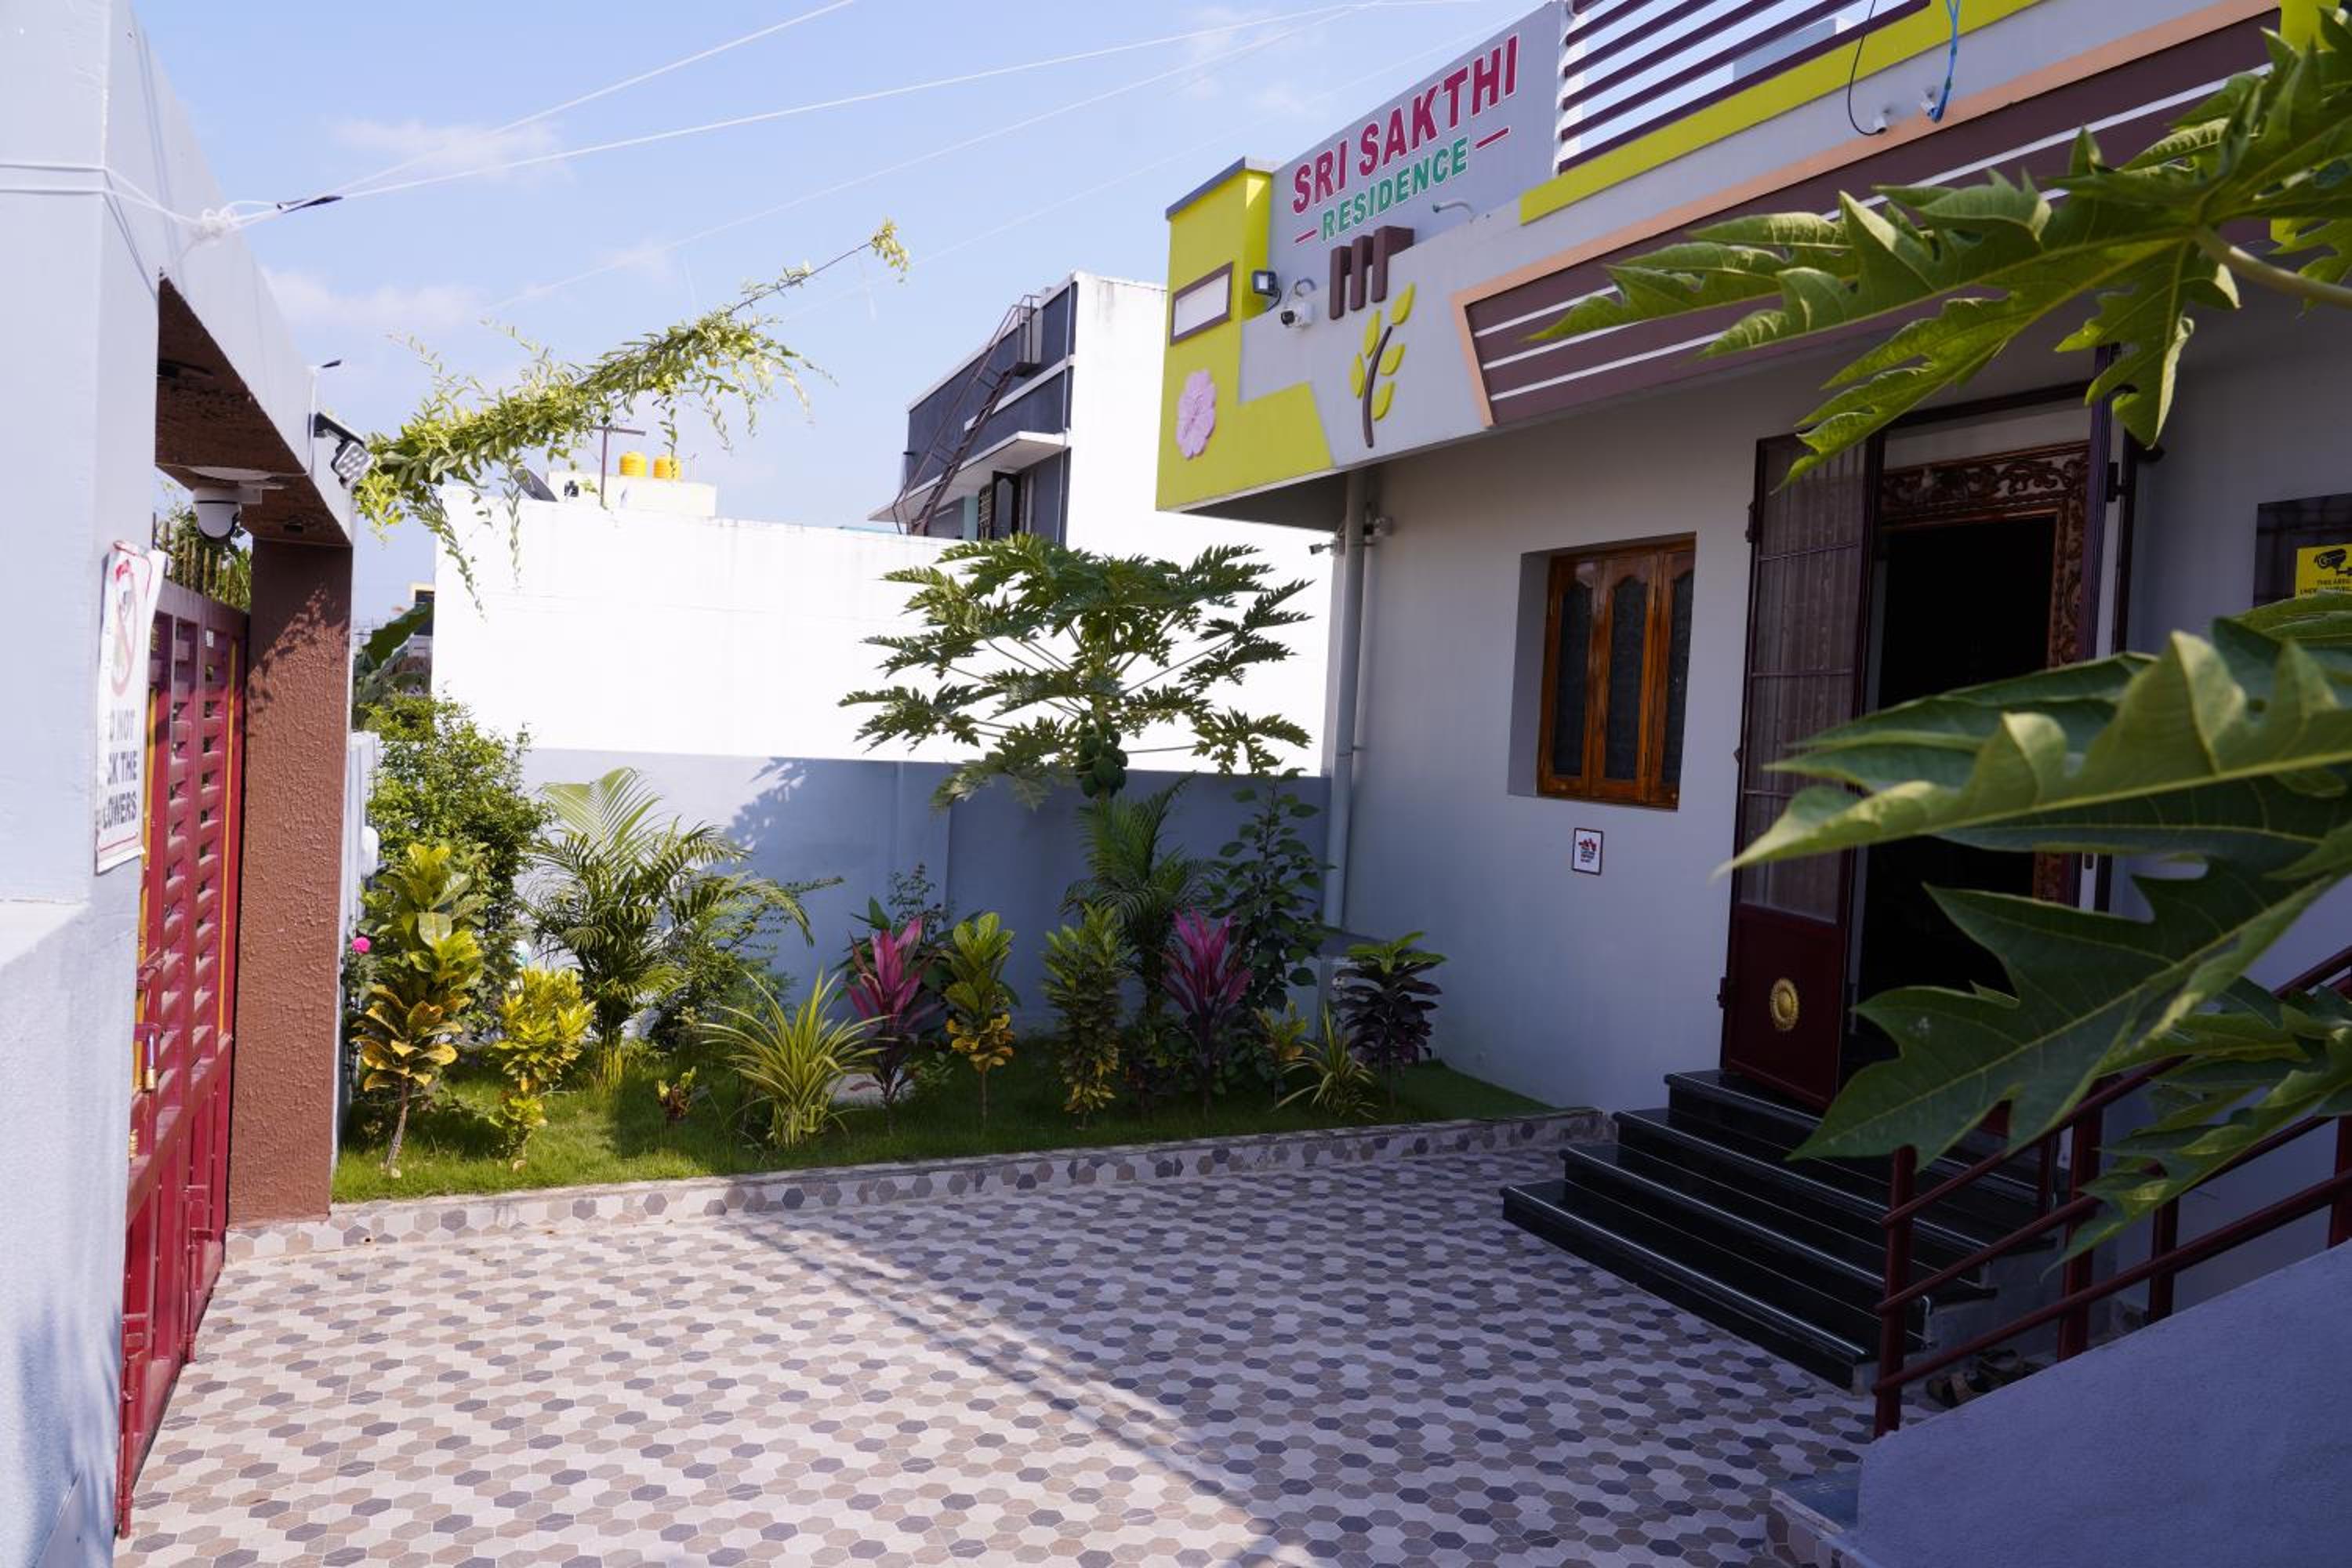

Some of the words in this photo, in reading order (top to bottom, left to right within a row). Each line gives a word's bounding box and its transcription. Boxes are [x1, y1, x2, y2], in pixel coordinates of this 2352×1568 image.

[1293, 140, 1348, 214] SRI
[1358, 34, 1519, 177] SAKTHI
[1321, 136, 1468, 241] RESIDENCE
[120, 750, 138, 782] THE
